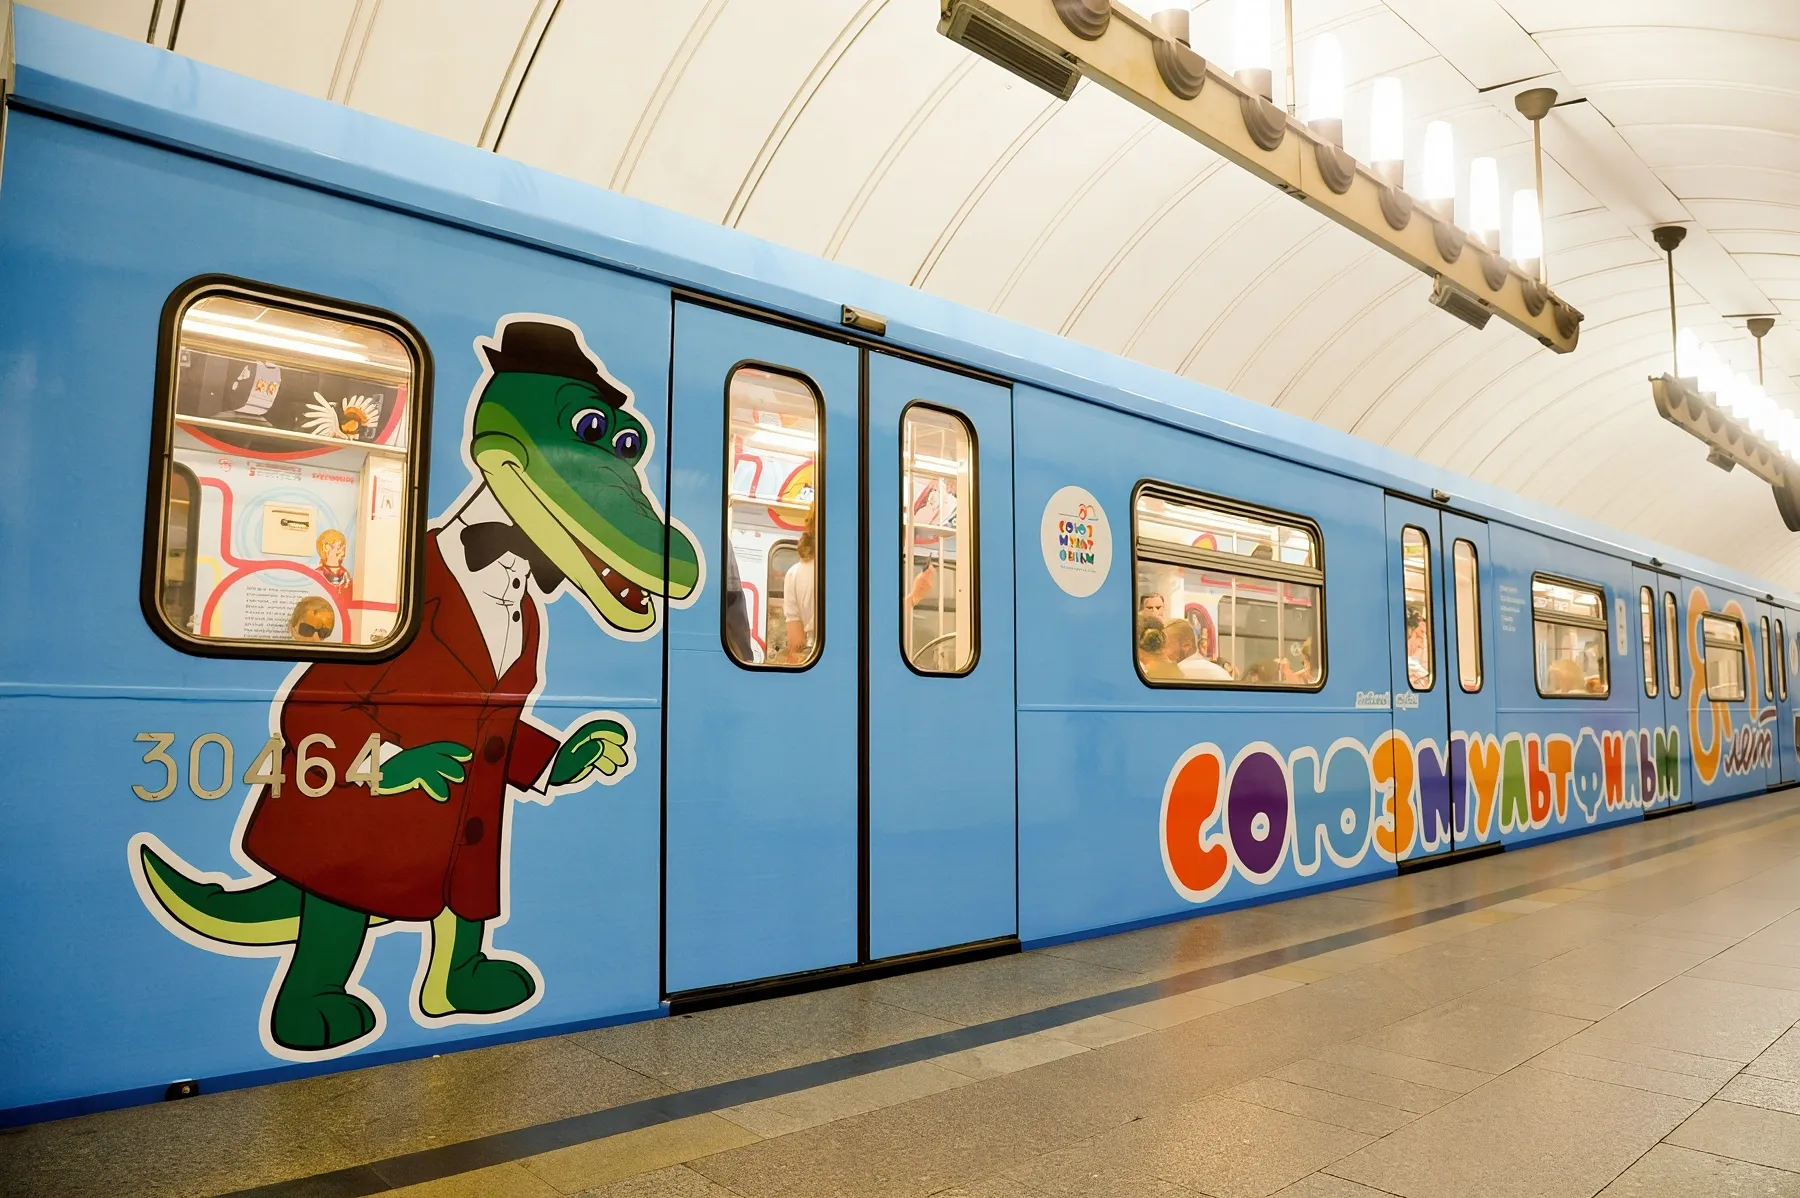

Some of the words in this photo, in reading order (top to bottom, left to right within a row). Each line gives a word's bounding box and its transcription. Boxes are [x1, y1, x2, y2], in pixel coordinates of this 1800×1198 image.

[131, 732, 383, 802] 30464
[1723, 706, 1777, 776] лет
[1161, 727, 1681, 902] СОЮЗМУЛЬТФИЛЬМ
